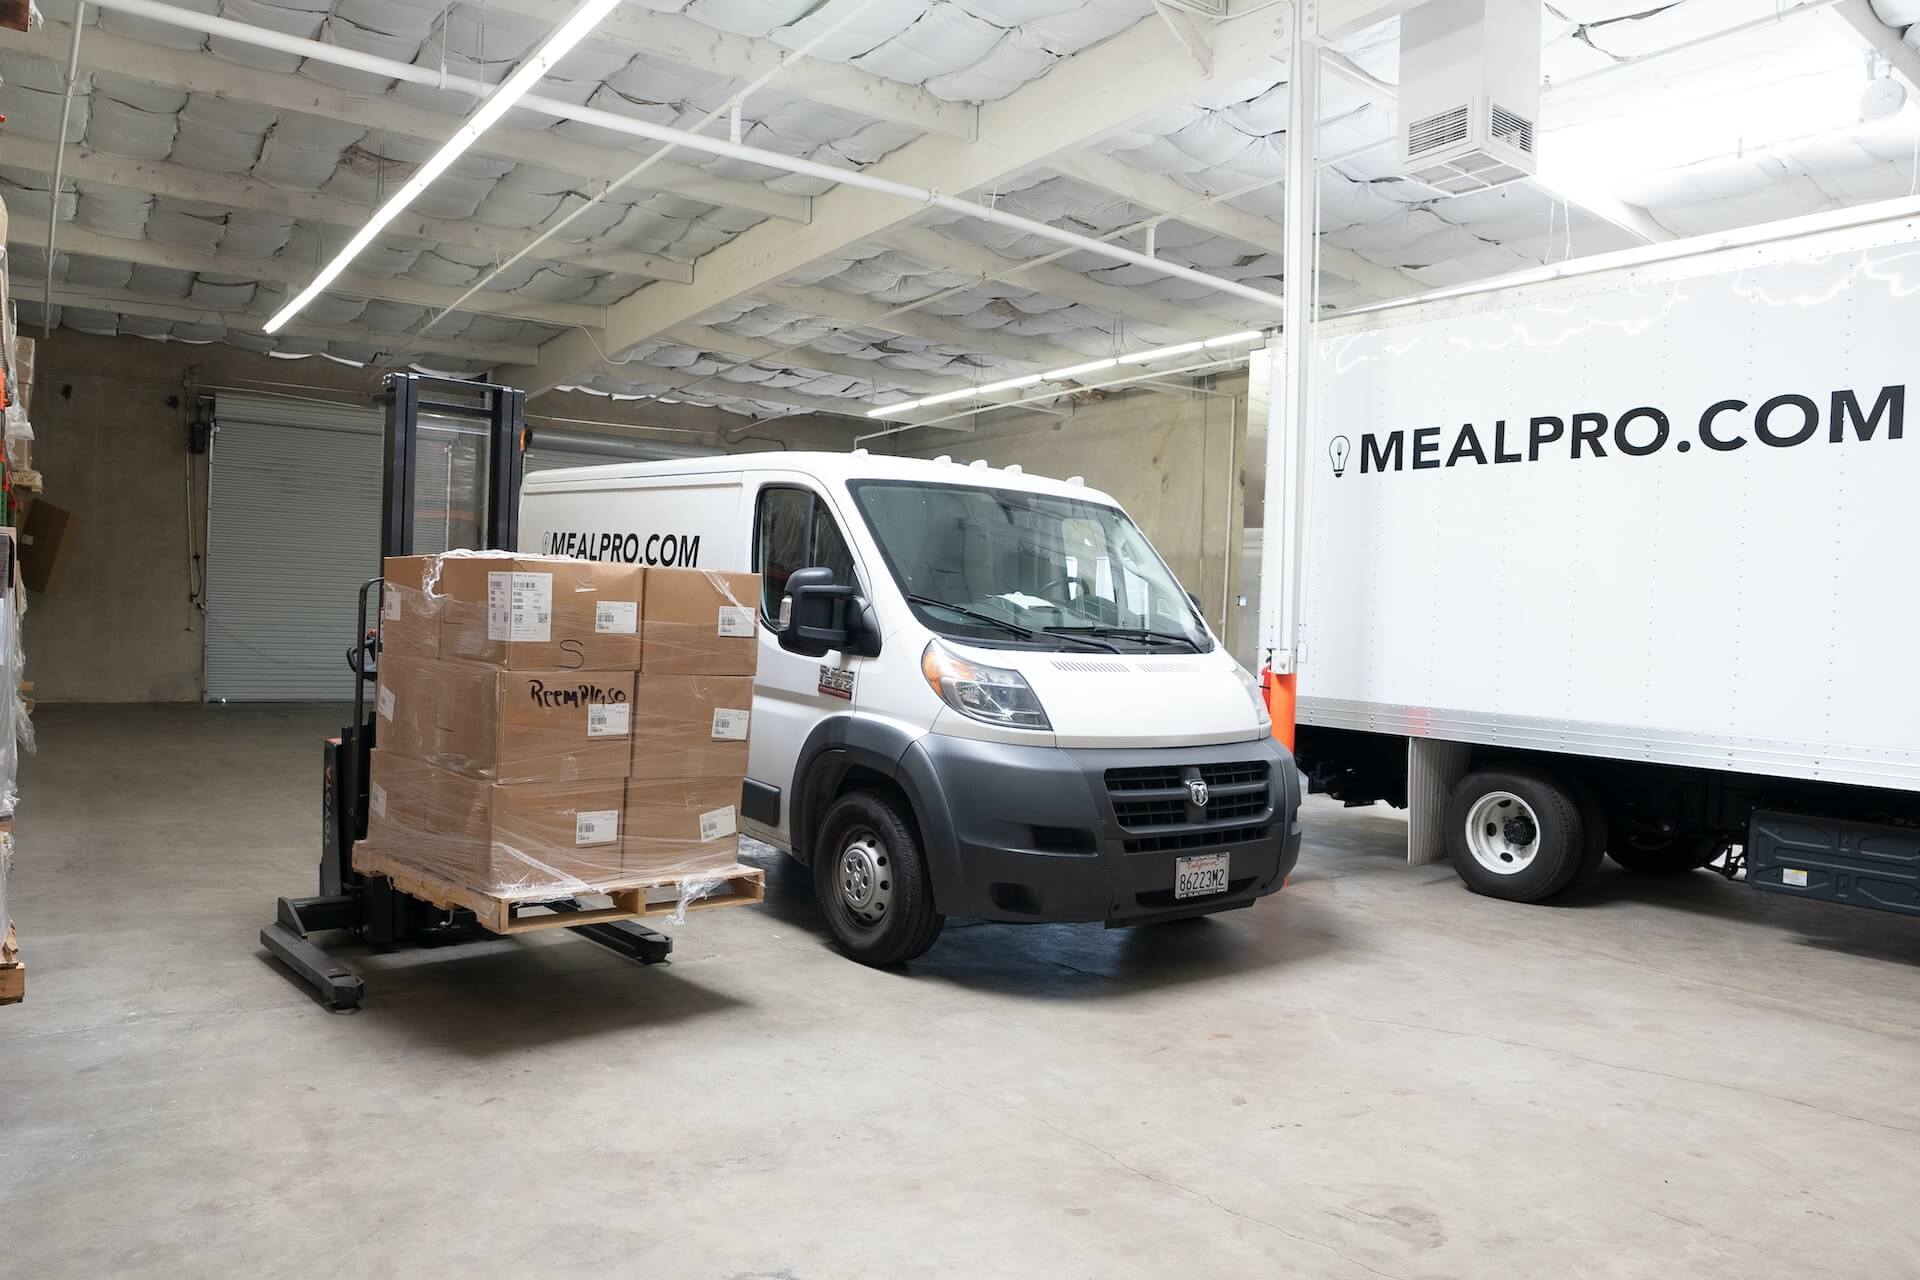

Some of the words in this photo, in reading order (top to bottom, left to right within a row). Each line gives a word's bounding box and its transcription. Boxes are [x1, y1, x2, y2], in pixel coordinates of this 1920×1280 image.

[1359, 384, 1906, 474] MEALPRO.COM
[551, 532, 700, 568] MEALPRO.COM
[551, 639, 585, 669] S
[324, 766, 332, 848] TOYOTA
[1180, 869, 1225, 892] 86223M2
